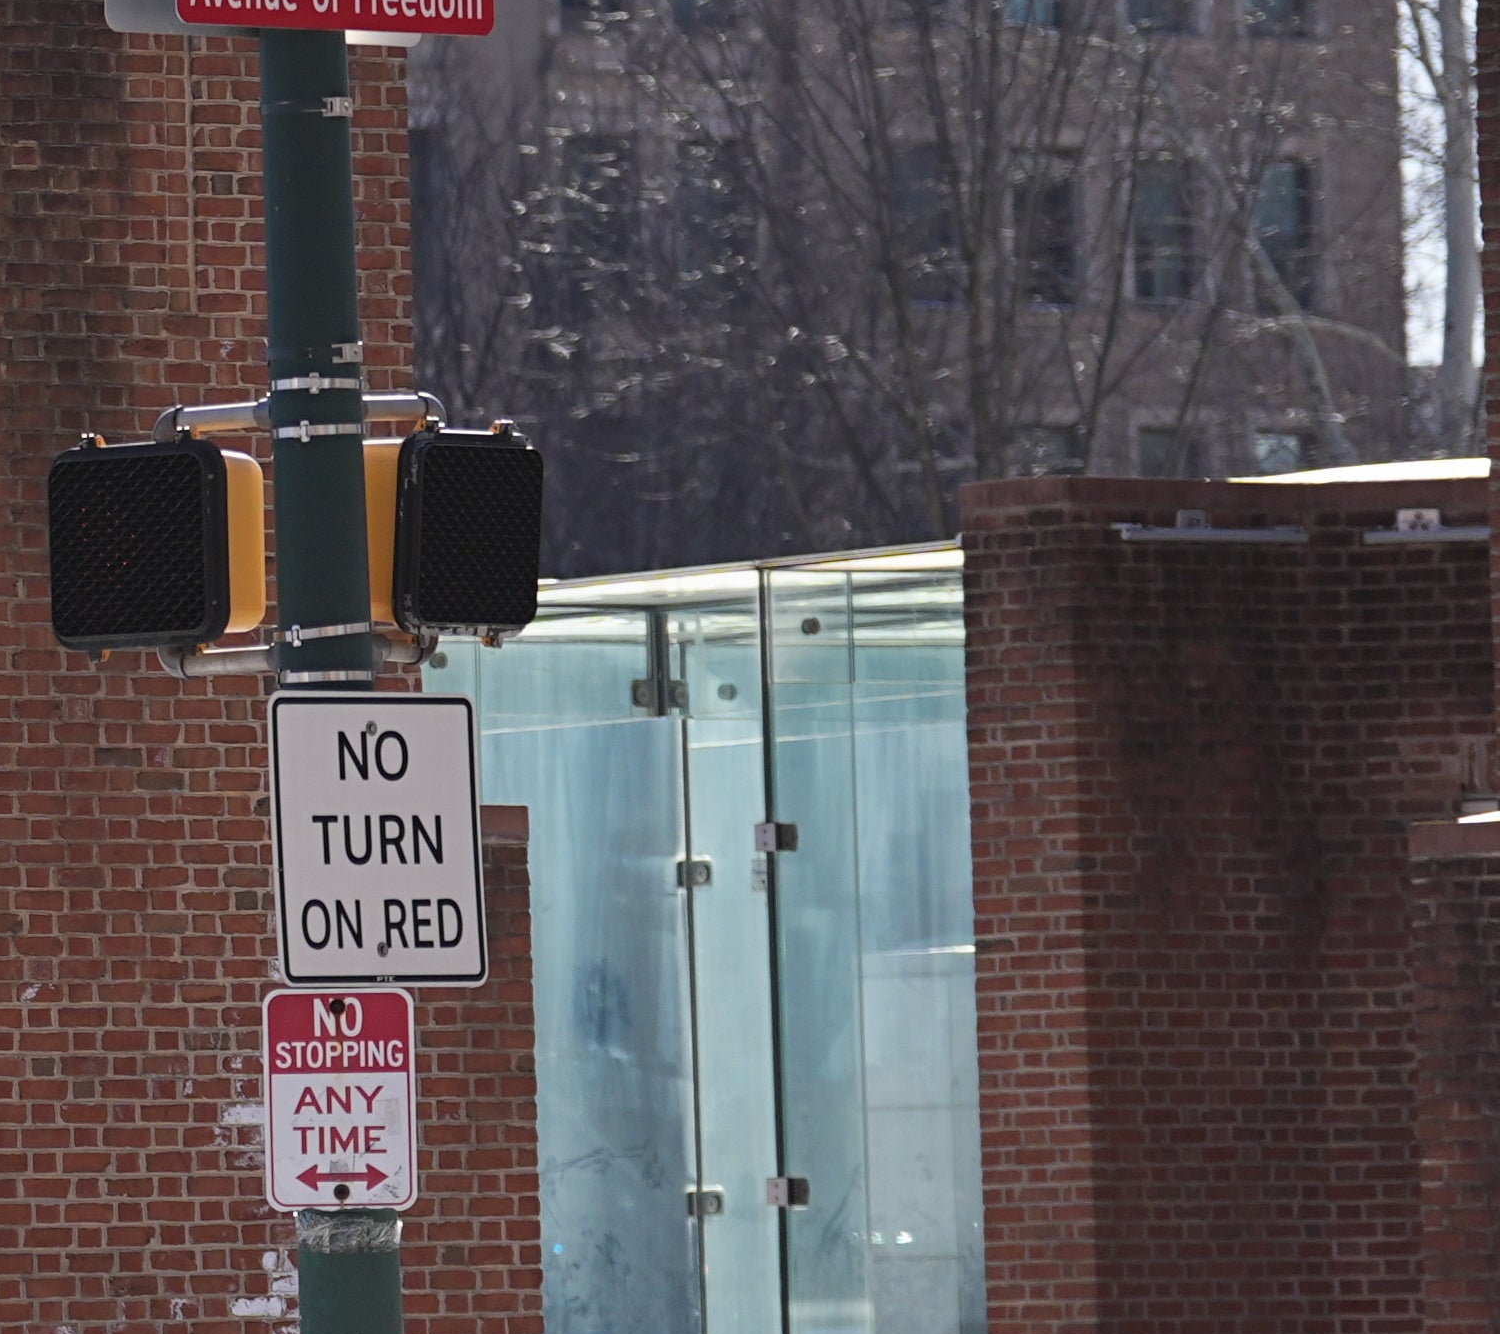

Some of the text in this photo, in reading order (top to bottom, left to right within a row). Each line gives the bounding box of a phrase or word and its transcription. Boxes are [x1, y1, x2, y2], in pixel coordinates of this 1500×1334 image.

[337, 730, 409, 782] NO
[311, 814, 445, 866] TURN
[301, 898, 464, 951] ON RED
[312, 996, 364, 1039] NO
[274, 1039, 405, 1070] STOPPING
[293, 1085, 385, 1116] ANY
[292, 1125, 389, 1156] TIME
